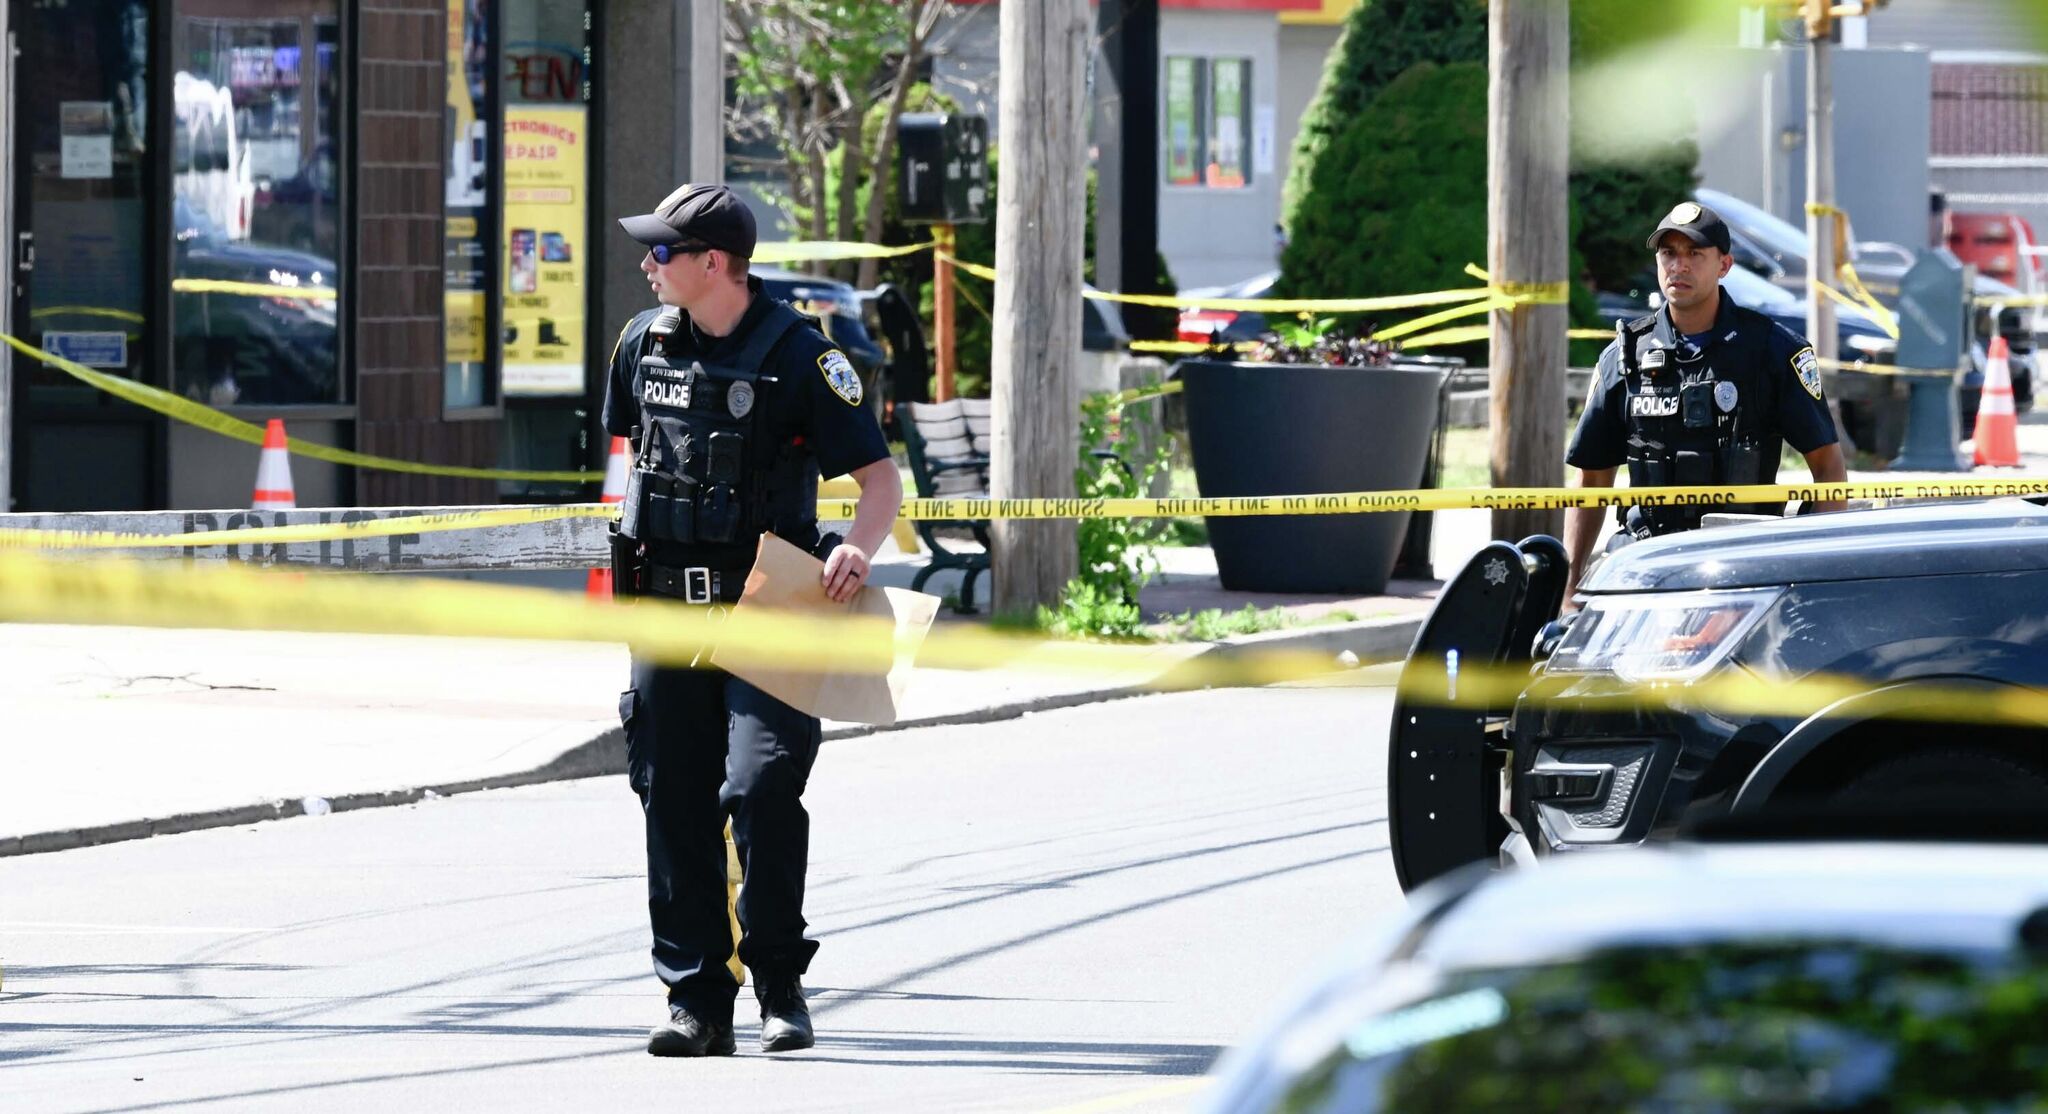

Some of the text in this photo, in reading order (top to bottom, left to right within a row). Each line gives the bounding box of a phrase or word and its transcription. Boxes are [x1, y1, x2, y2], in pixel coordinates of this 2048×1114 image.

[504, 54, 580, 99] PEN
[644, 380, 689, 406] POLICE
[1633, 396, 1678, 414] POLICE
